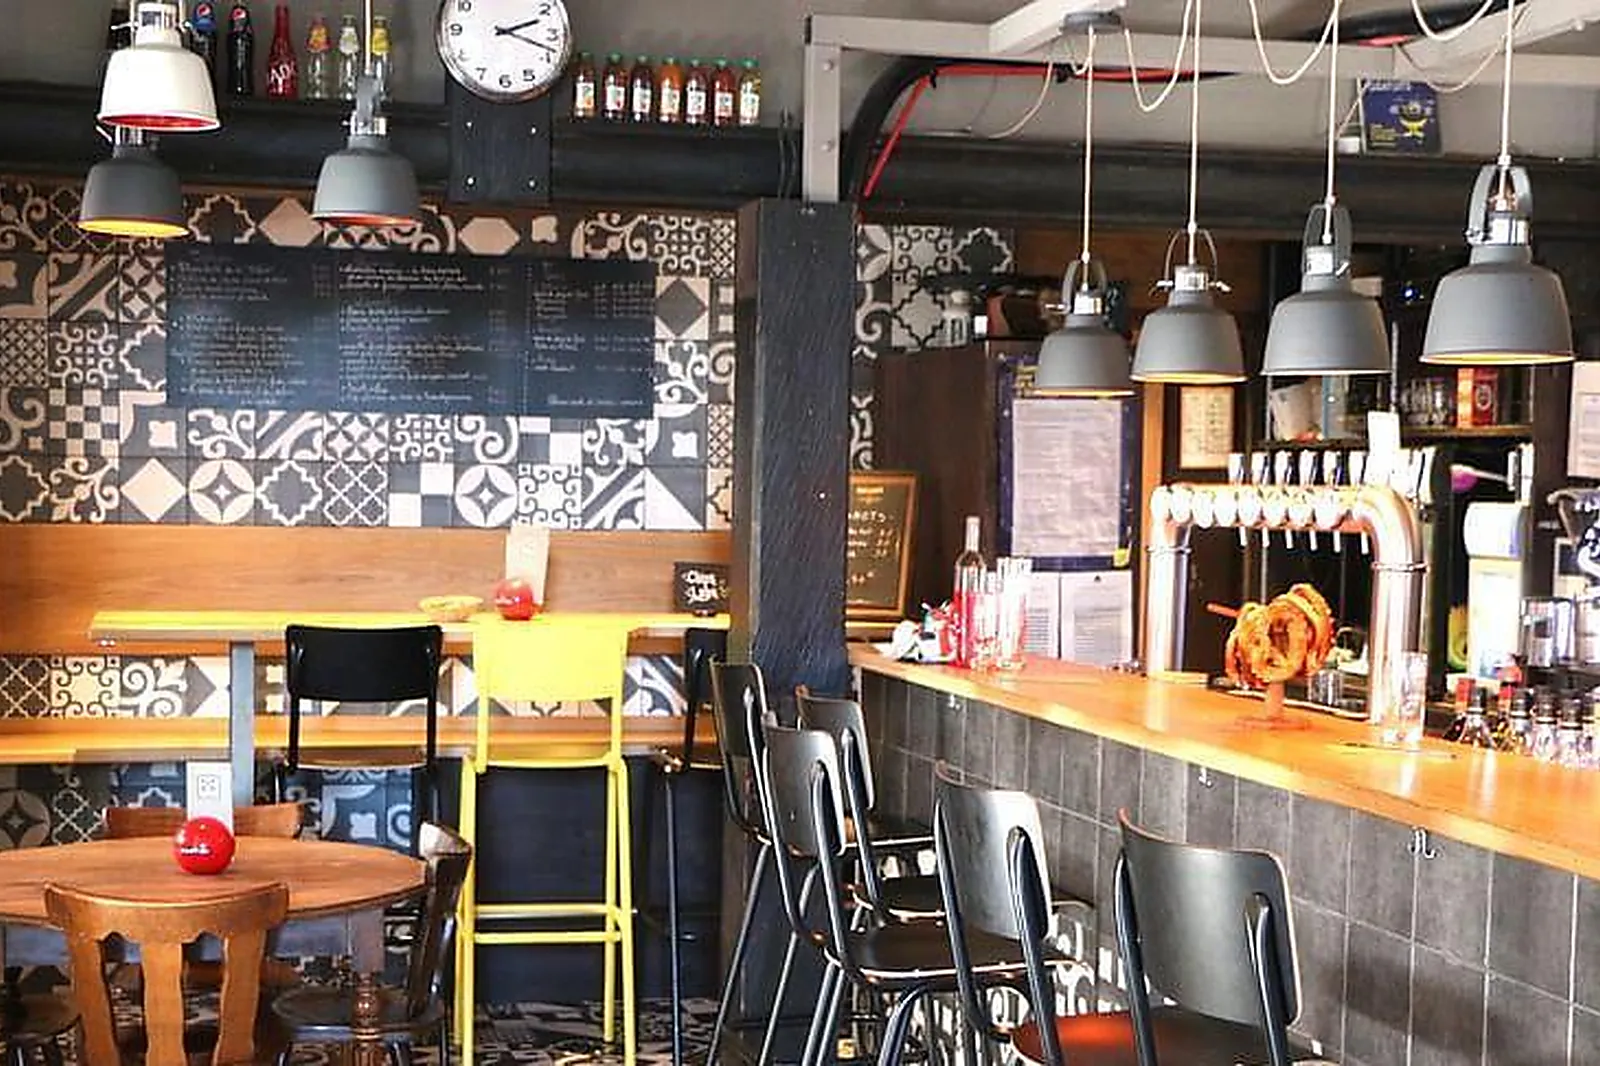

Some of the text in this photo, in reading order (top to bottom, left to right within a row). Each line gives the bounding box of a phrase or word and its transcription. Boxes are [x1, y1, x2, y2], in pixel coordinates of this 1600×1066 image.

[457, 0, 472, 12] 10
[539, 3, 551, 16] 2
[450, 23, 463, 36] 9
[546, 28, 559, 42] 3
[475, 66, 487, 80] 7
[523, 68, 536, 82] 5
[498, 74, 512, 88] 6
